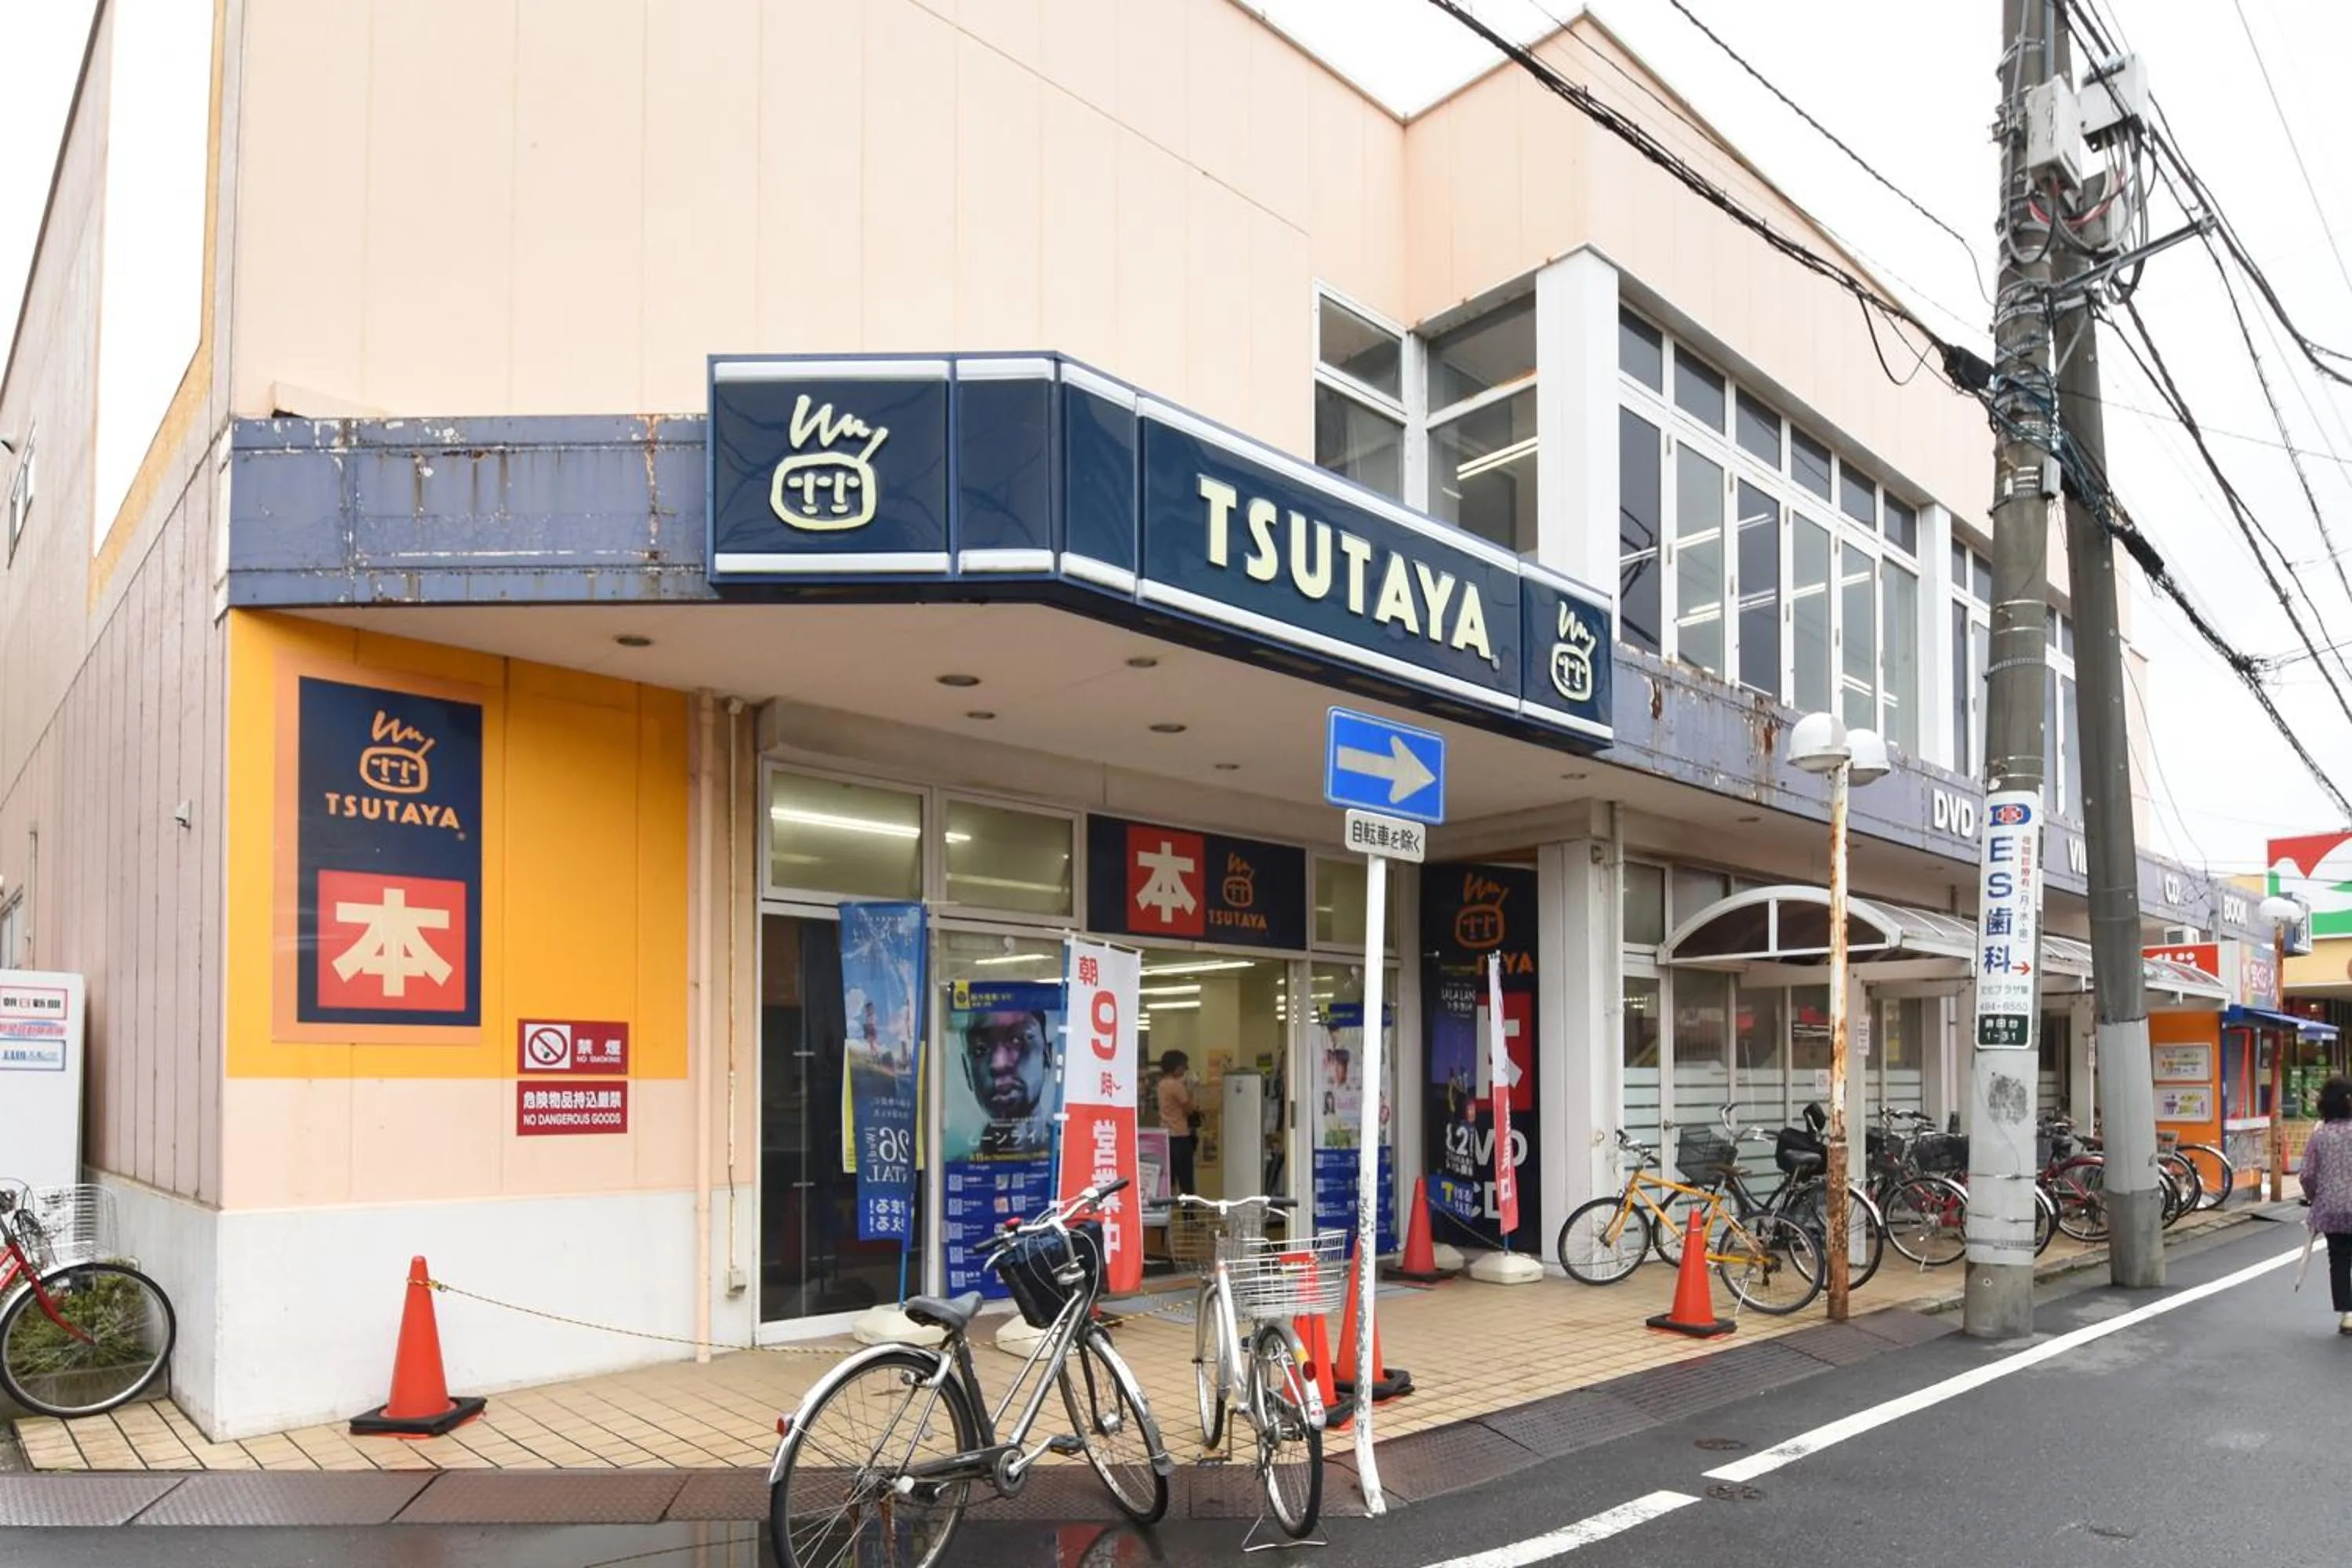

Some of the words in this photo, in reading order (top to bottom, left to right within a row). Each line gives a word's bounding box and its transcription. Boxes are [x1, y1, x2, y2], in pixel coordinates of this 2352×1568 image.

[1197, 474, 1492, 660] TSUTAYA
[325, 792, 460, 829] TSUTAYA
[1933, 788, 1975, 838] DVD
[1352, 819, 1421, 854] 自転車を除く
[1136, 840, 1197, 924] 本
[2165, 873, 2180, 905] CD
[1207, 908, 1268, 930] TSUTAYA
[332, 887, 453, 998] 本
[523, 1113, 537, 1126] NO
[538, 1112, 590, 1125] DANGEROUS
[591, 1112, 622, 1124] GOODS
